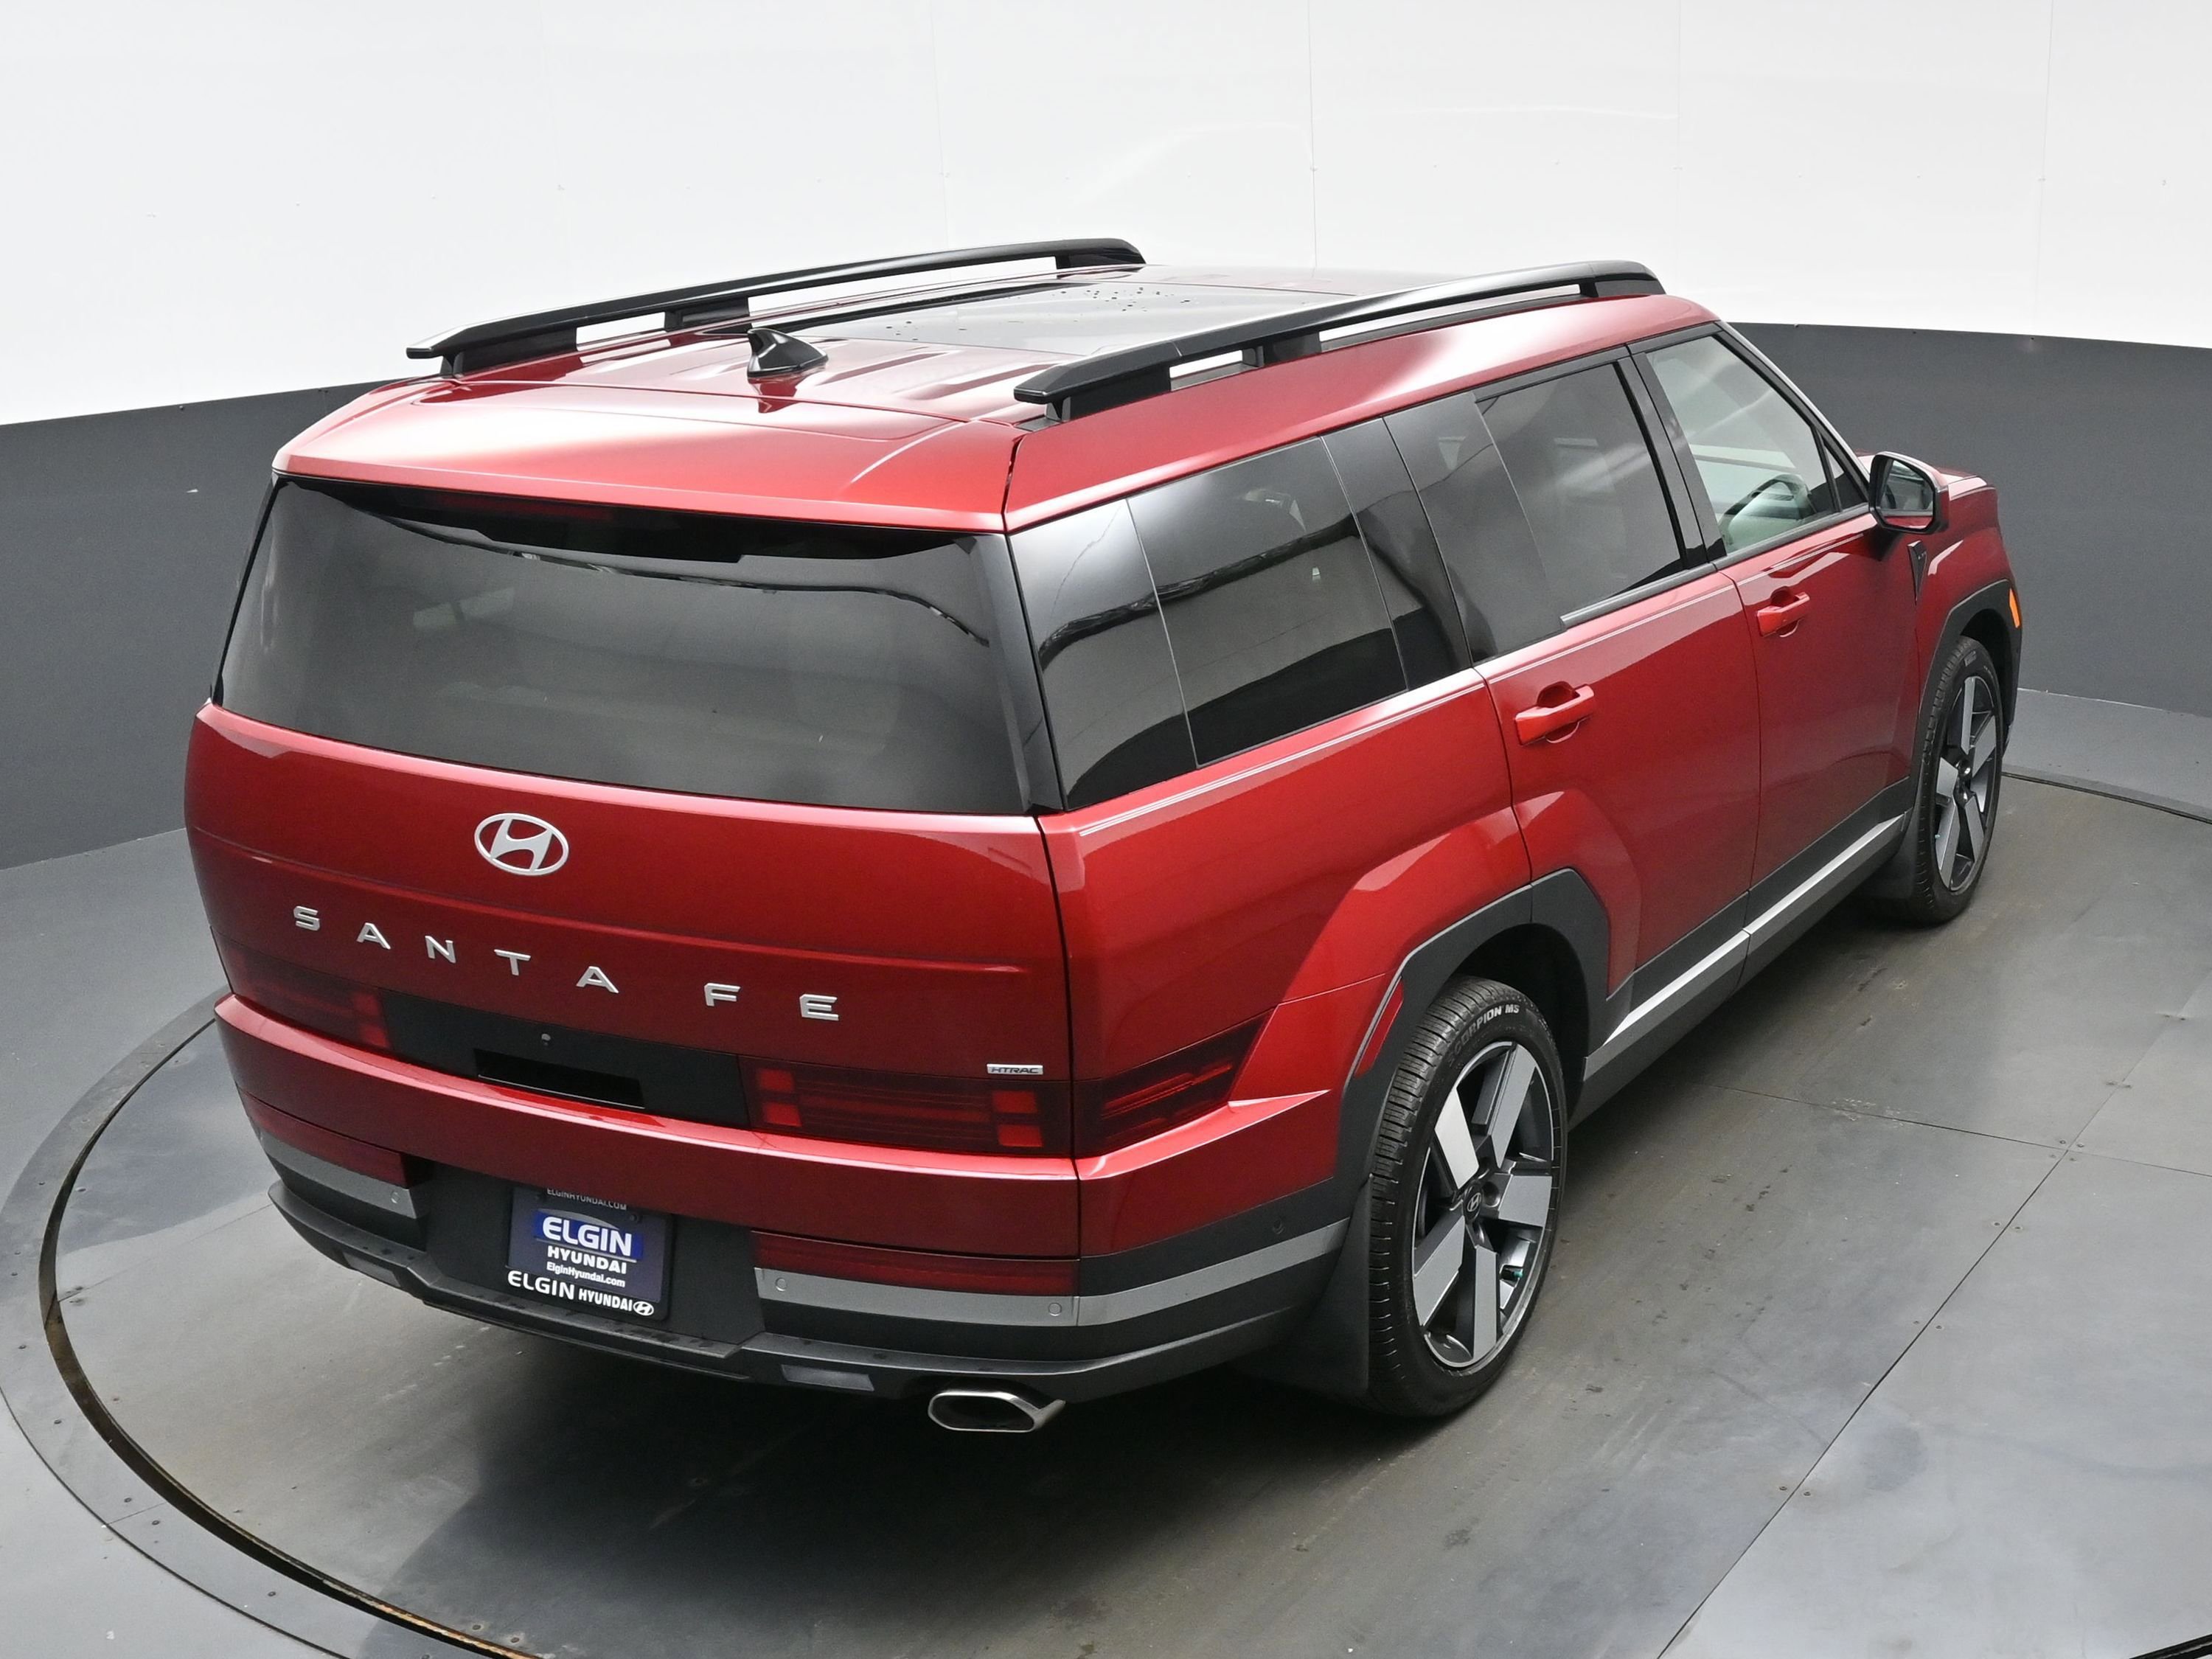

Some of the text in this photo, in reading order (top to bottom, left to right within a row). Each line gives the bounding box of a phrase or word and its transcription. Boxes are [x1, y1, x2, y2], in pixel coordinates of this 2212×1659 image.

[293, 905, 838, 1020] SANTA FE
[543, 1217, 632, 1256] ELGIN
[546, 1262, 626, 1287] ElginHyundai.com
[547, 1245, 627, 1274] HYUNDAI
[507, 1270, 633, 1312] ELGIN HYUNDAI
